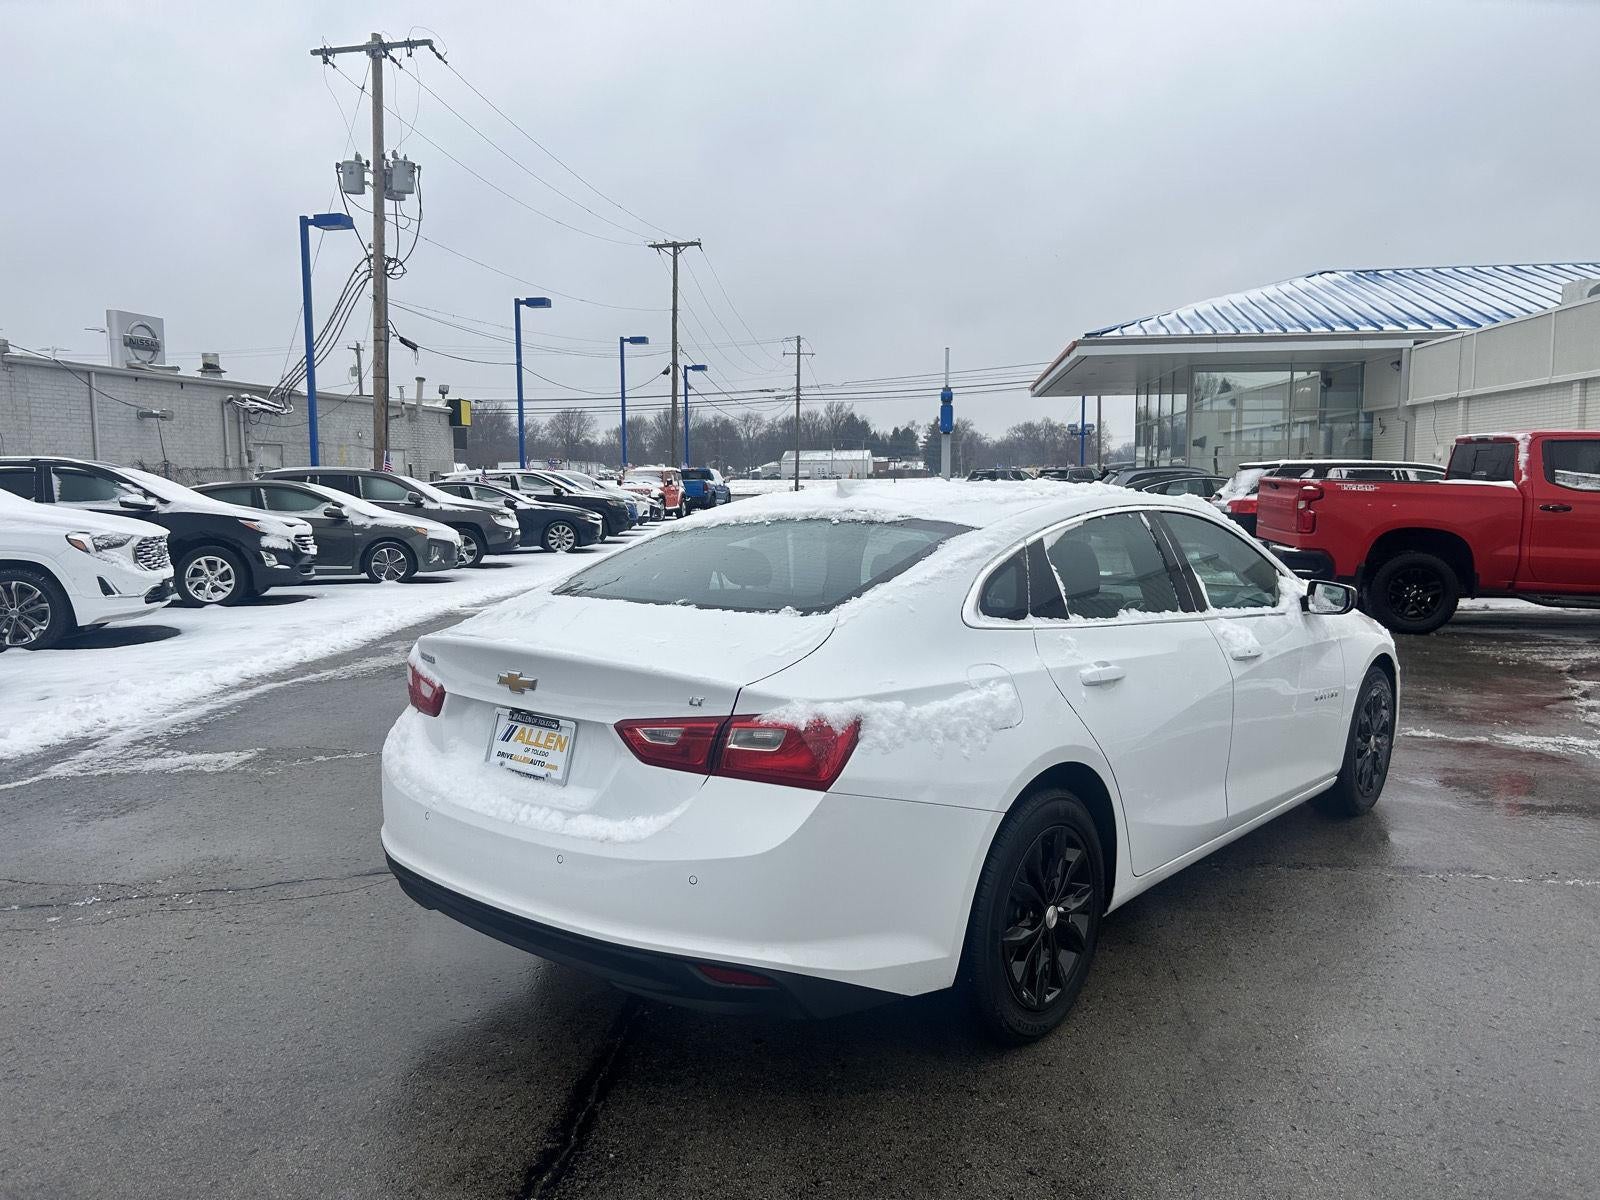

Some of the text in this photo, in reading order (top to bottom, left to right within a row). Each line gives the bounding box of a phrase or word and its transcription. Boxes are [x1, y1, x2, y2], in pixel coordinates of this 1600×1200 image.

[129, 338, 160, 348] NISSAN
[689, 696, 705, 707] LT
[513, 727, 568, 752] ALLEN
[531, 748, 549, 757] TOLEDO
